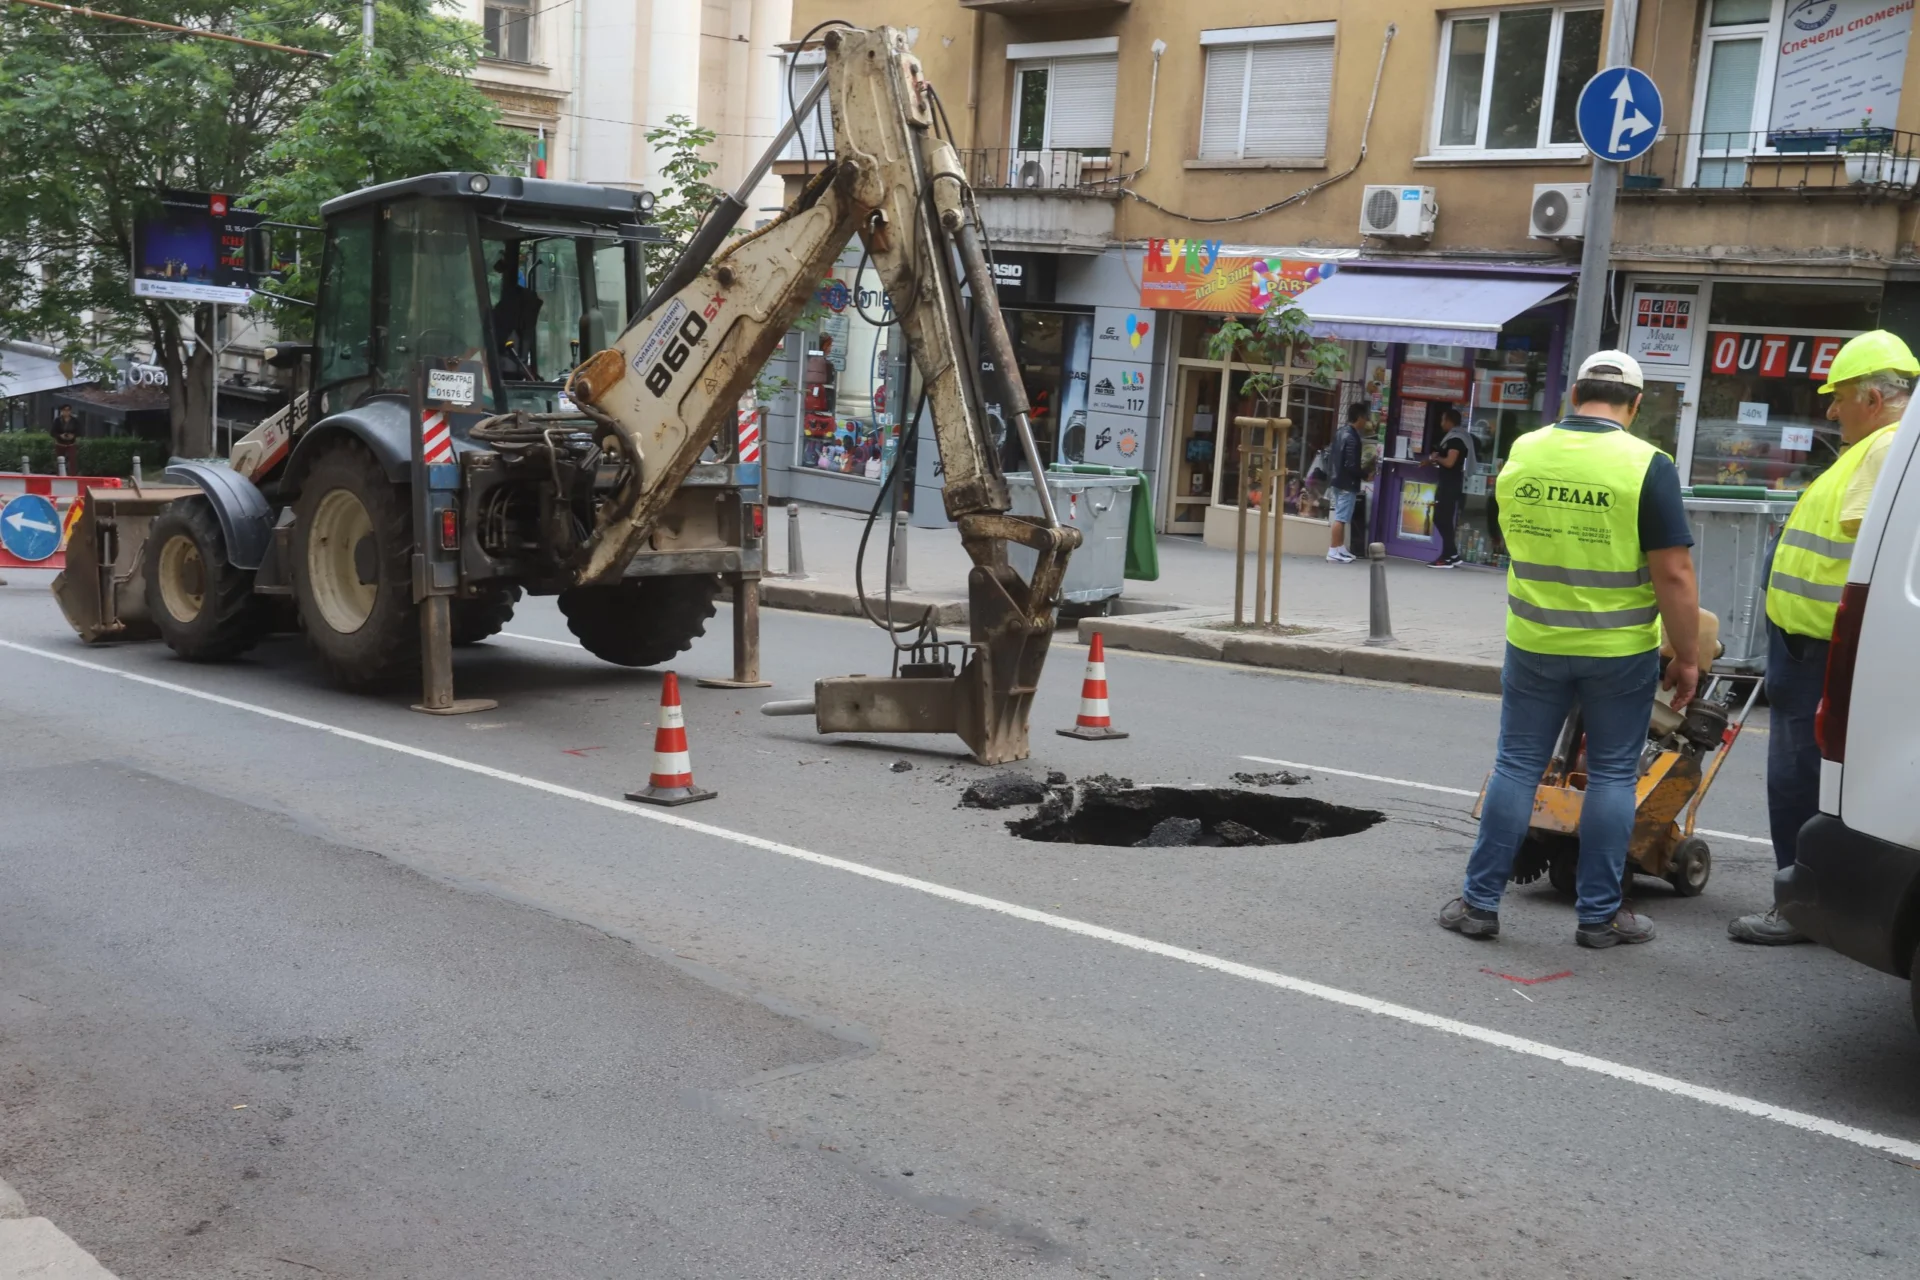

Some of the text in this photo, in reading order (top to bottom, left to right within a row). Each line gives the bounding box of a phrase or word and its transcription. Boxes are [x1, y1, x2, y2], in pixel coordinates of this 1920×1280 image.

[1782, 25, 1844, 55] Спечели
[1847, 0, 1915, 32] спомени
[1266, 279, 1313, 293] PART
[645, 291, 727, 398] 860 SX
[1714, 337, 1840, 374] OUTLE
[432, 372, 472, 384] СОФИЯ-ГРАД
[436, 388, 461, 398] 01676
[1127, 398, 1144, 412] 117
[276, 399, 309, 435] TERE
[1546, 486, 1610, 507] ГЕЛАК
